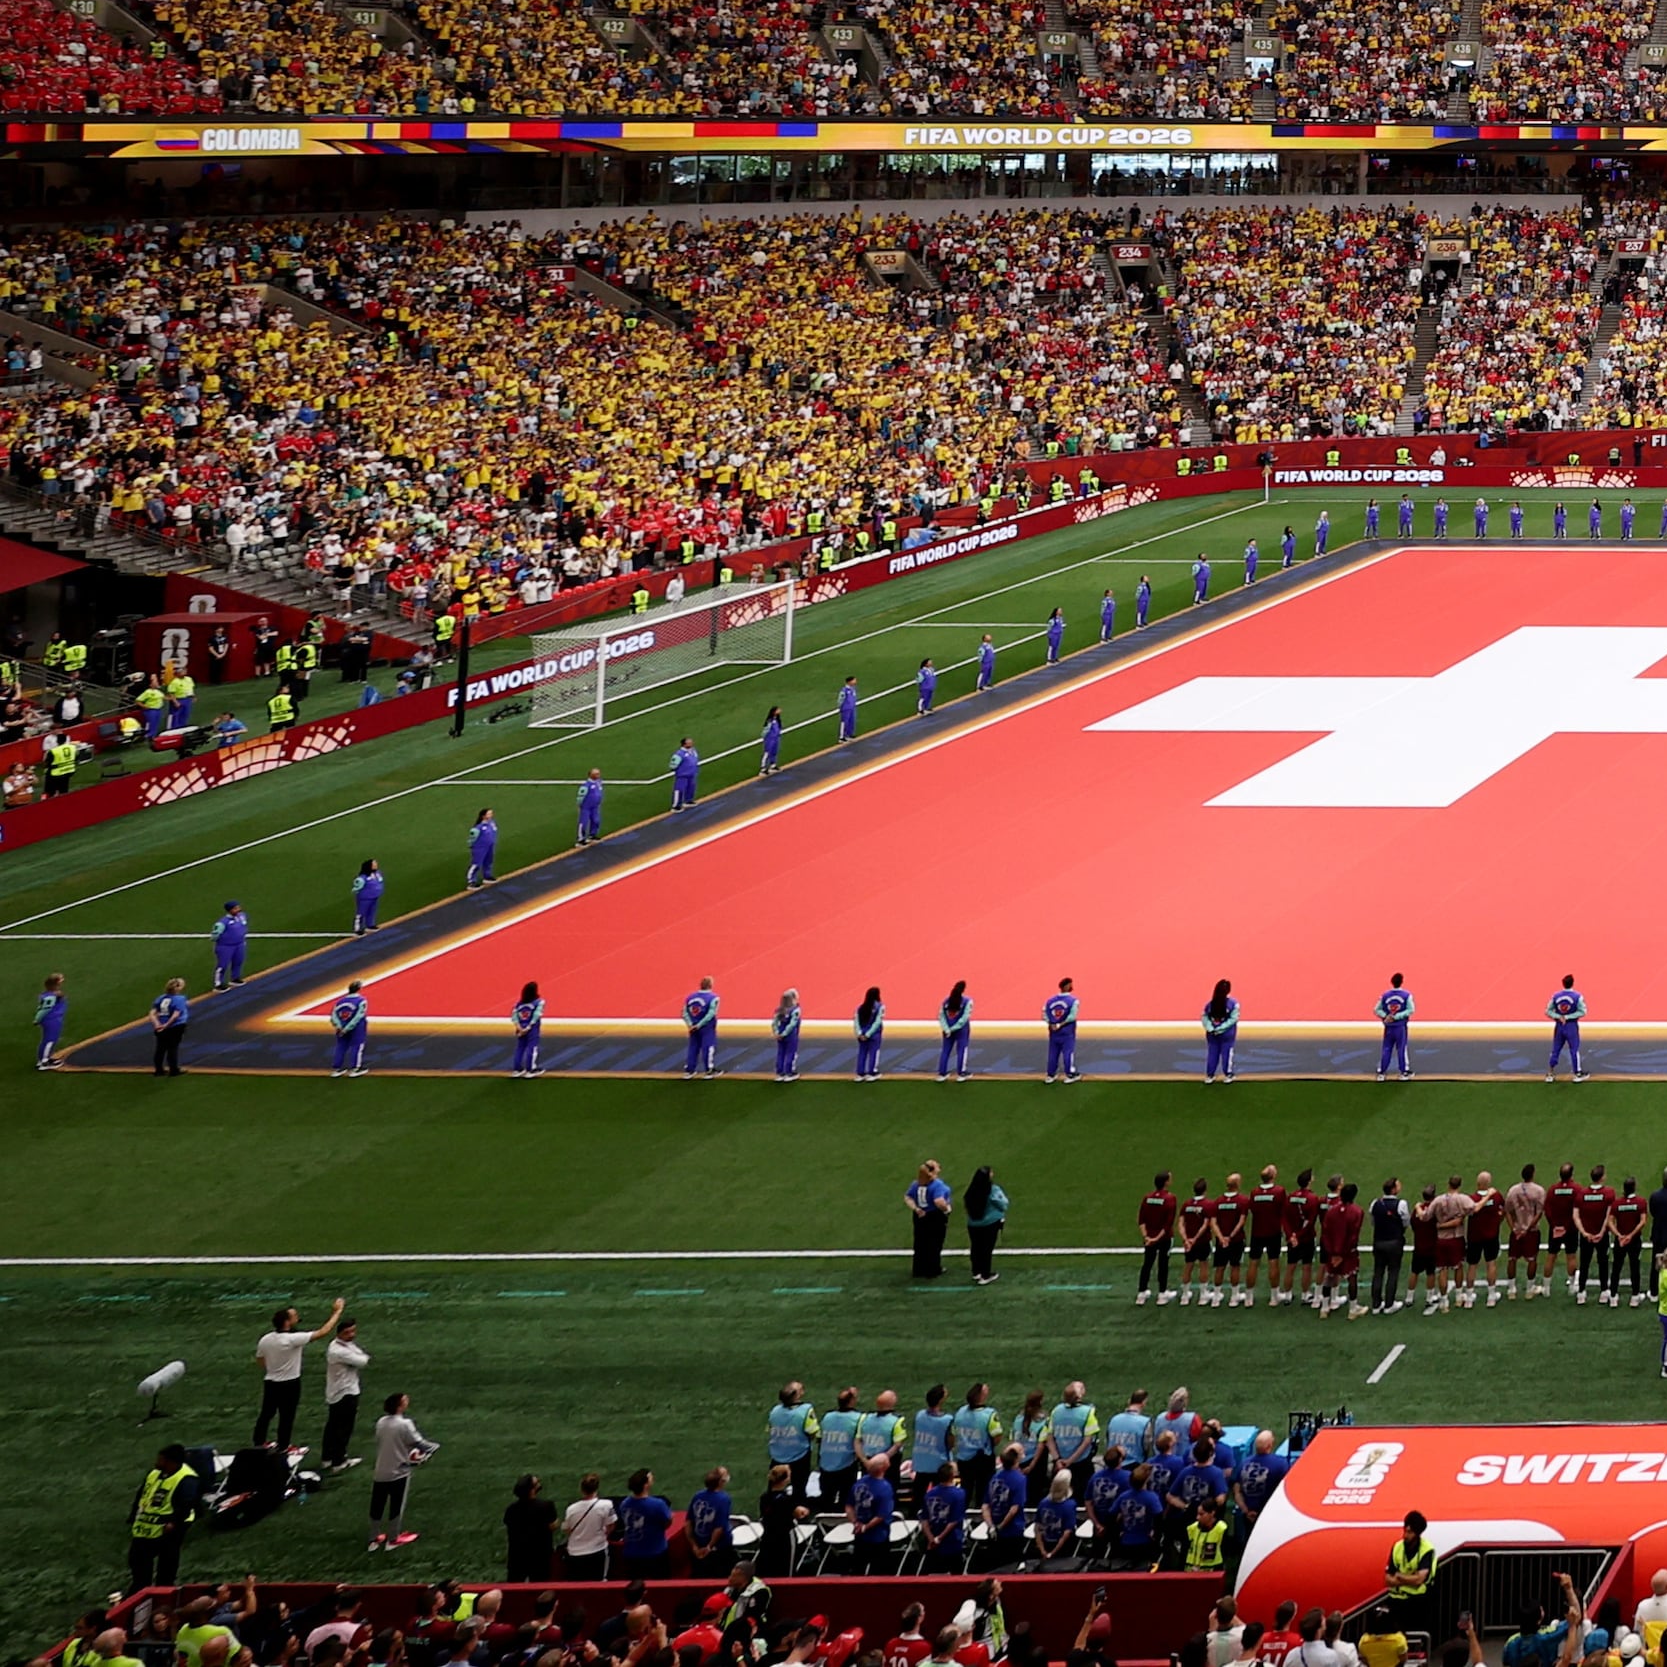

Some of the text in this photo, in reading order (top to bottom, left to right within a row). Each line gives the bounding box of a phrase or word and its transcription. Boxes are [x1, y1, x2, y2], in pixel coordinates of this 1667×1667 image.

[355, 12, 376, 24] 431
[603, 21, 624, 33] 432
[832, 28, 853, 40] 433
[1047, 35, 1066, 46] 434
[1254, 39, 1273, 51] 435
[1454, 43, 1471, 54] 436
[1647, 45, 1664, 55] 437
[202, 128, 300, 151] COLOMBIA
[905, 128, 1193, 145] FIFA WORLD CUP 2026
[1118, 247, 1141, 258] 234
[1436, 242, 1456, 253] 236
[1625, 241, 1644, 252] 237
[874, 254, 897, 265] 233
[1274, 470, 1444, 482] FIFA WORLD CUP 2026
[889, 524, 1018, 575] FIFA WORLD CUP 2026
[447, 679, 490, 708] FFA
[490, 661, 558, 697] WORLD
[556, 647, 597, 676] CUP
[1321, 1494, 1373, 1505] 2026
